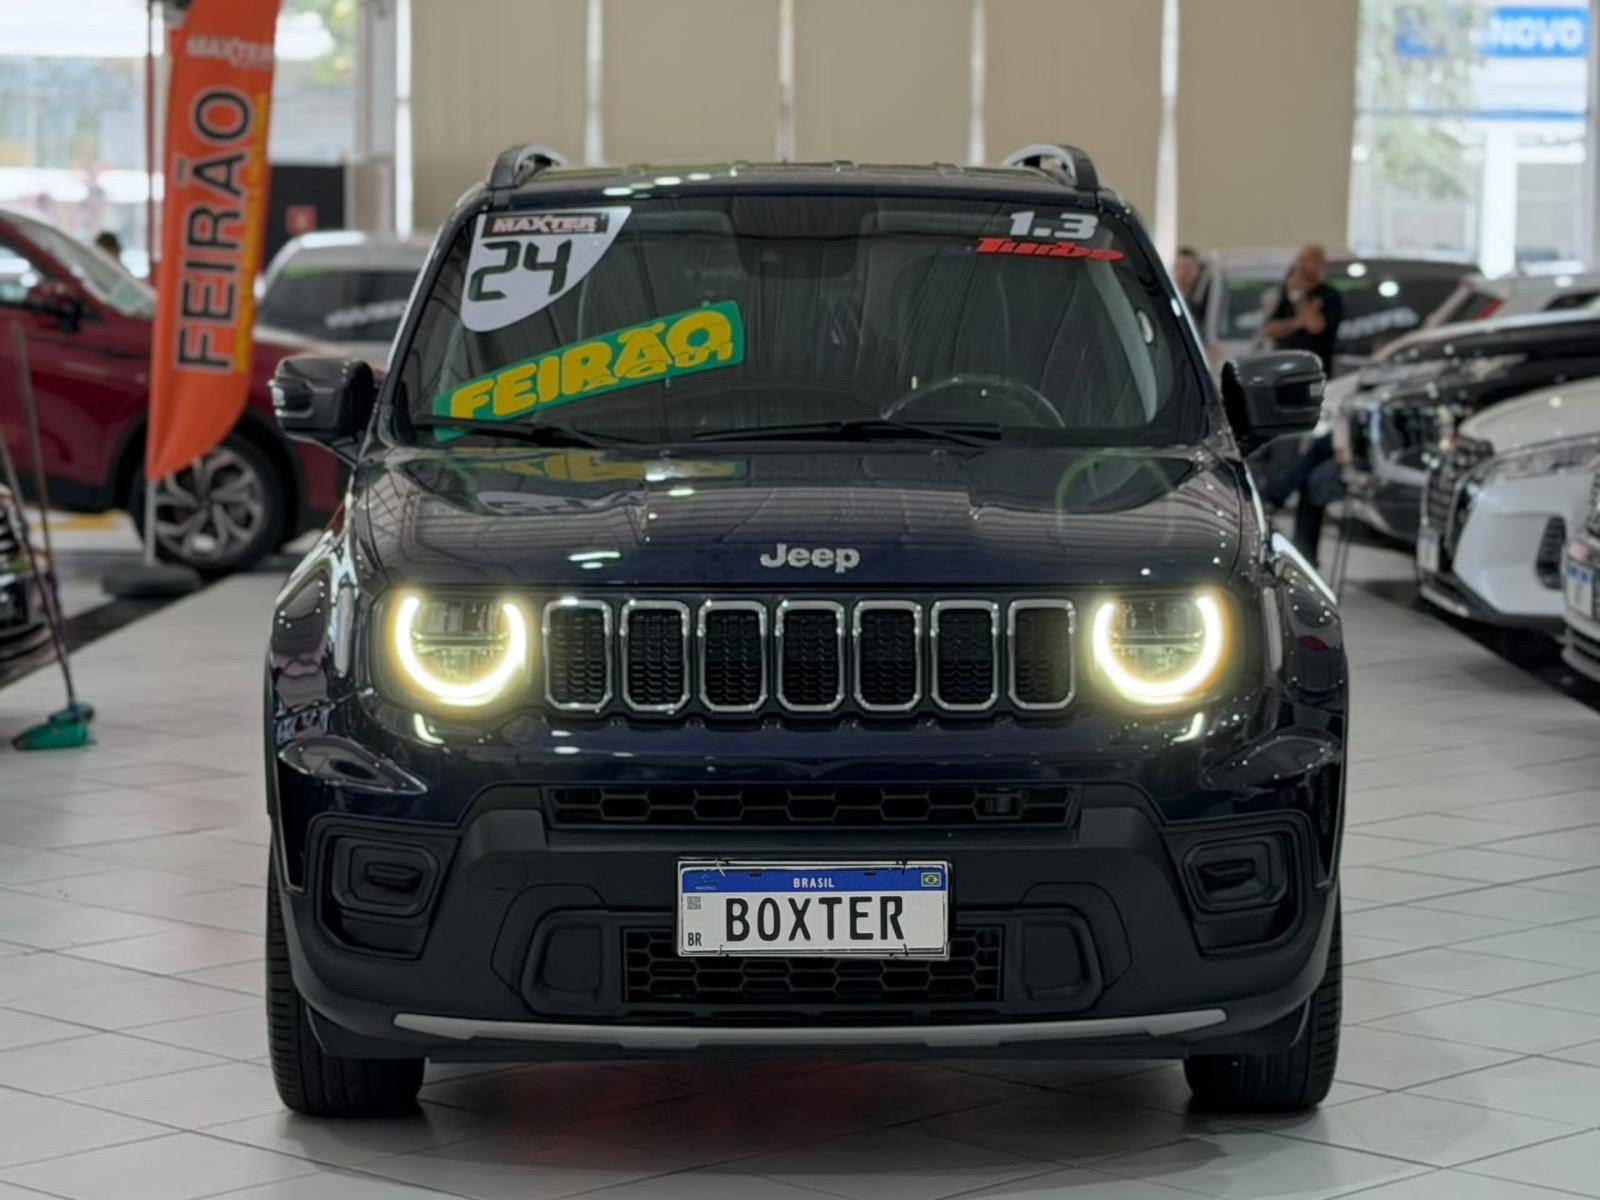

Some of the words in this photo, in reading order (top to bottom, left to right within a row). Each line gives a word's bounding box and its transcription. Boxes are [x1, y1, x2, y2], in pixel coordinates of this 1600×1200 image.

[176, 88, 254, 373] FEIRÃO
[491, 214, 598, 234] MAXTER
[1010, 211, 1098, 240] 1.3
[467, 239, 573, 302] 24
[451, 310, 734, 420] FEIRÃO
[760, 543, 860, 574] Jeep
[793, 877, 835, 889] BRASIL
[725, 896, 904, 942] BOXTER
[687, 932, 702, 947] BR
